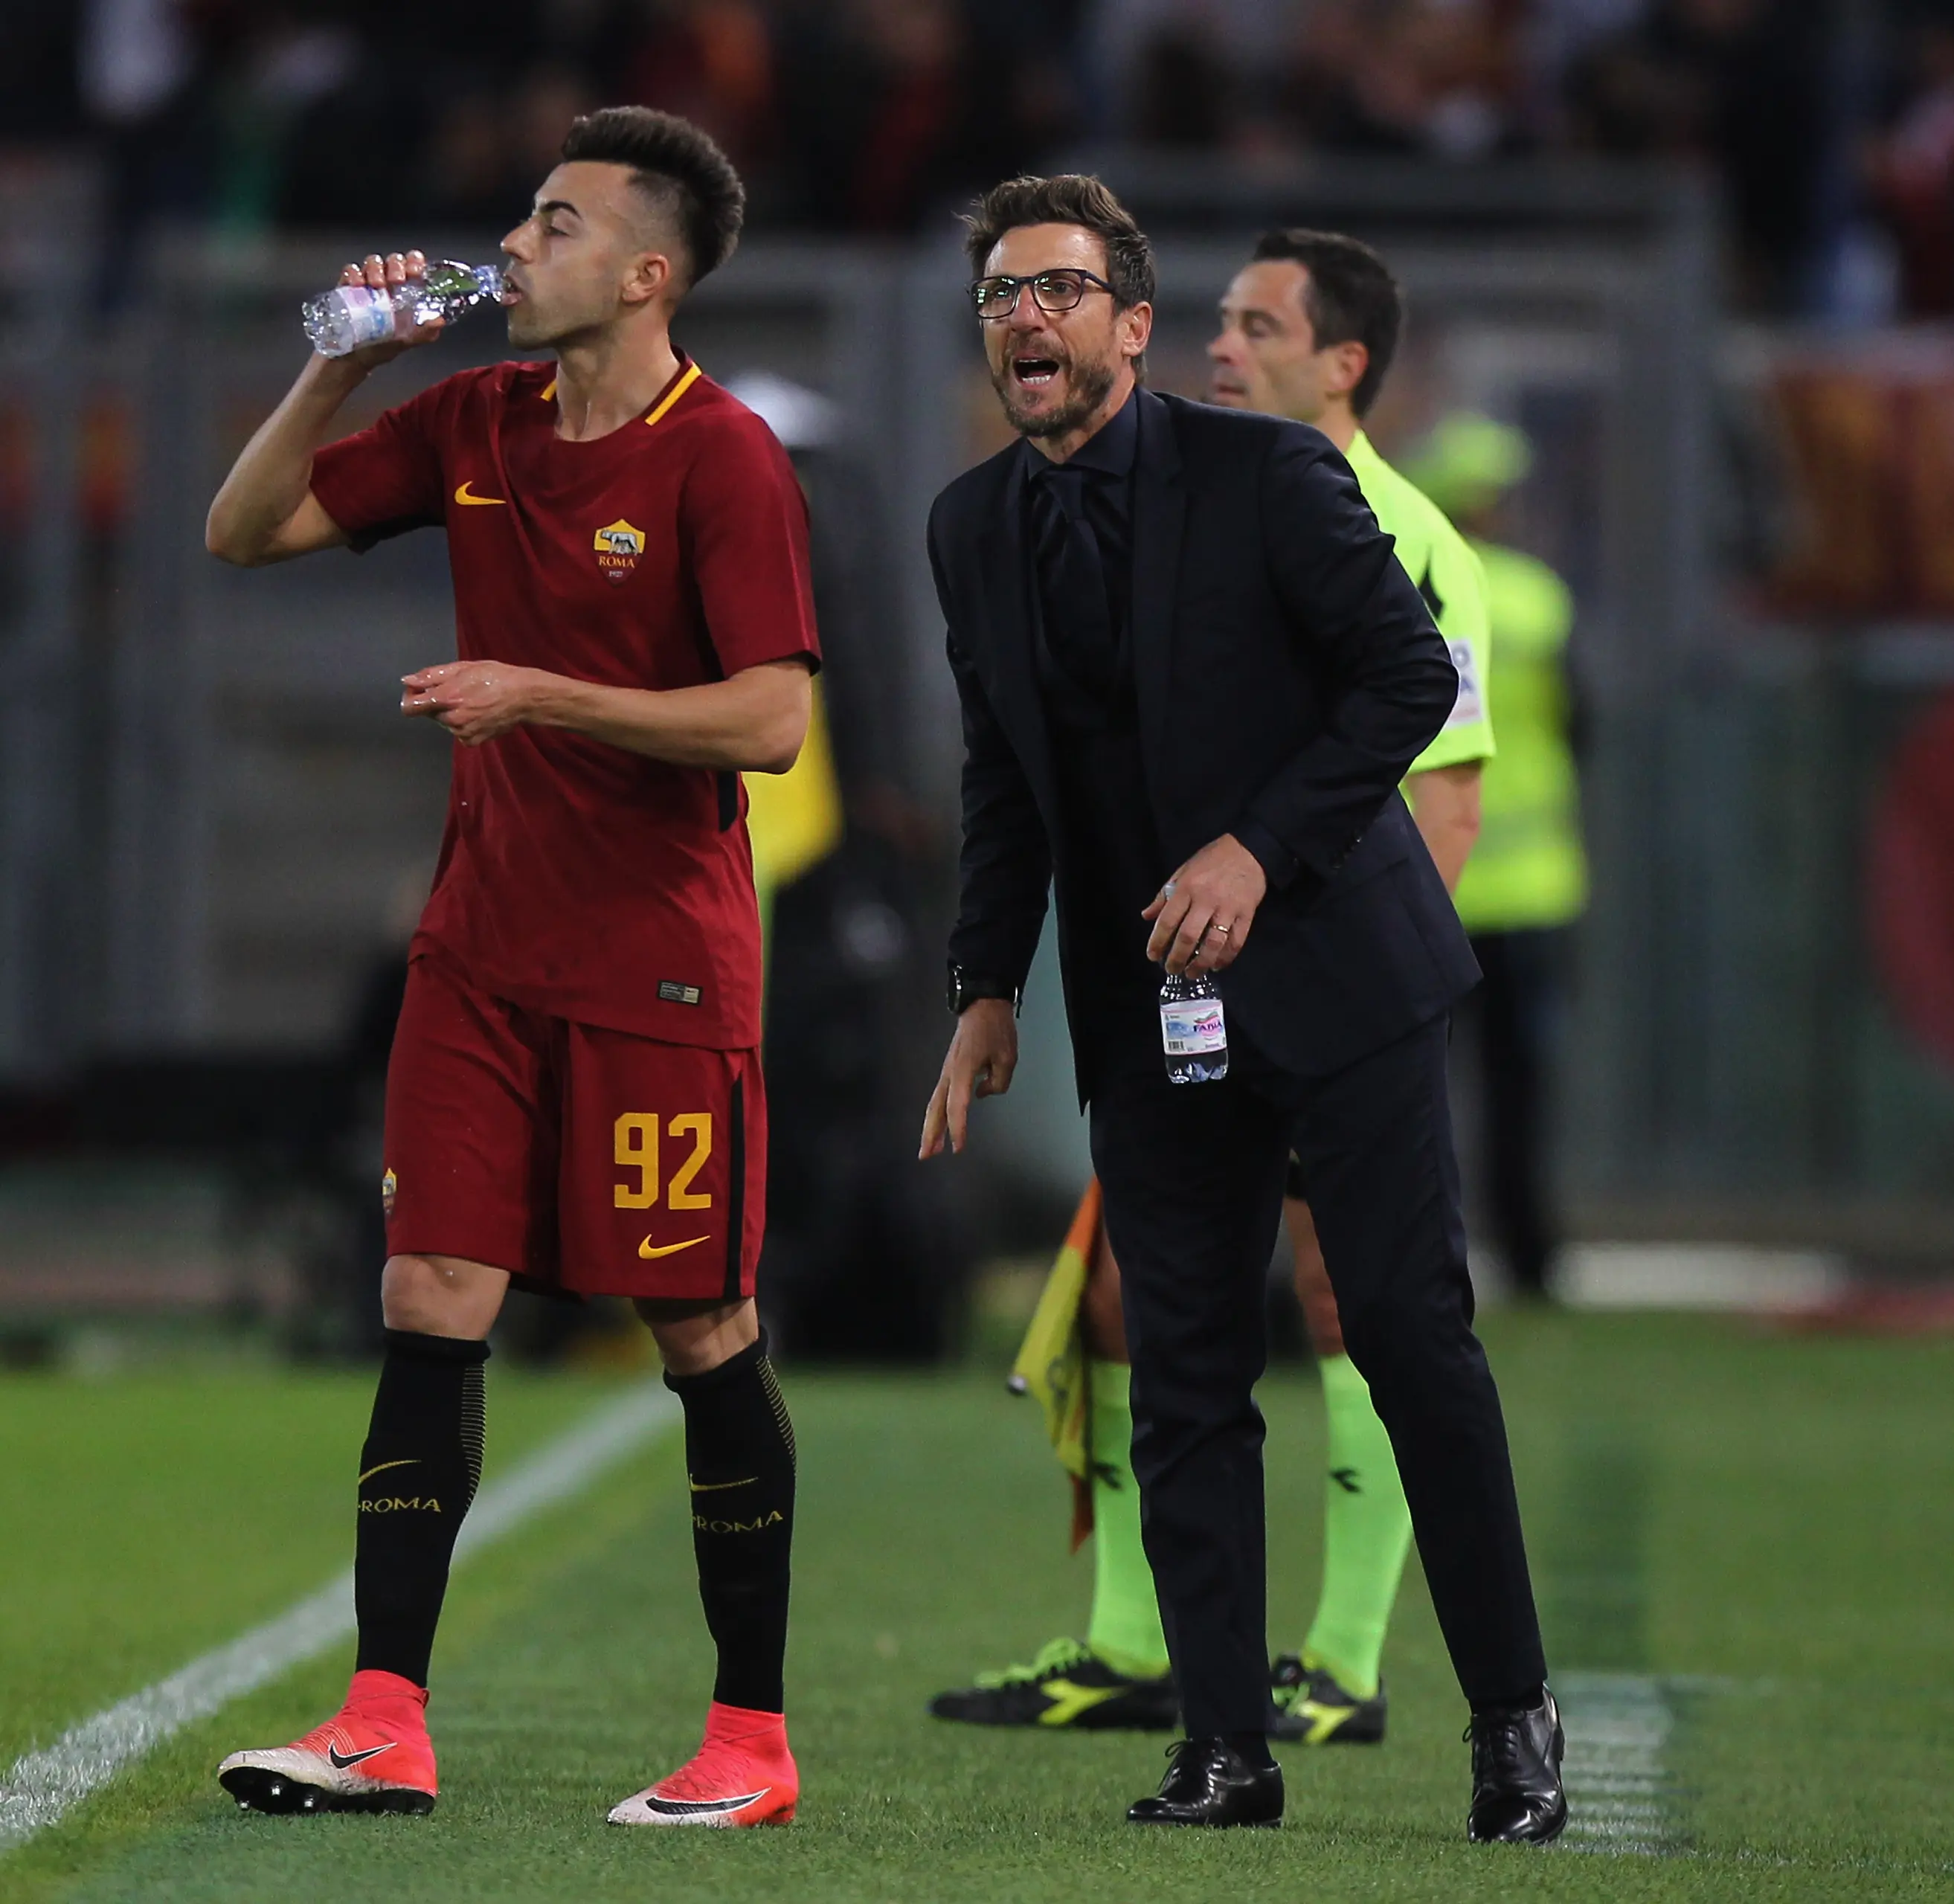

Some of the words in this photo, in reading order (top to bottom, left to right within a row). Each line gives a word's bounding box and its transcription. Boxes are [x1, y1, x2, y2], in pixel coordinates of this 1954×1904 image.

[599, 556, 635, 568] ROMA
[614, 1113, 712, 1209] 92
[361, 1496, 441, 1513] ROMA
[696, 1511, 783, 1533] ROMA
